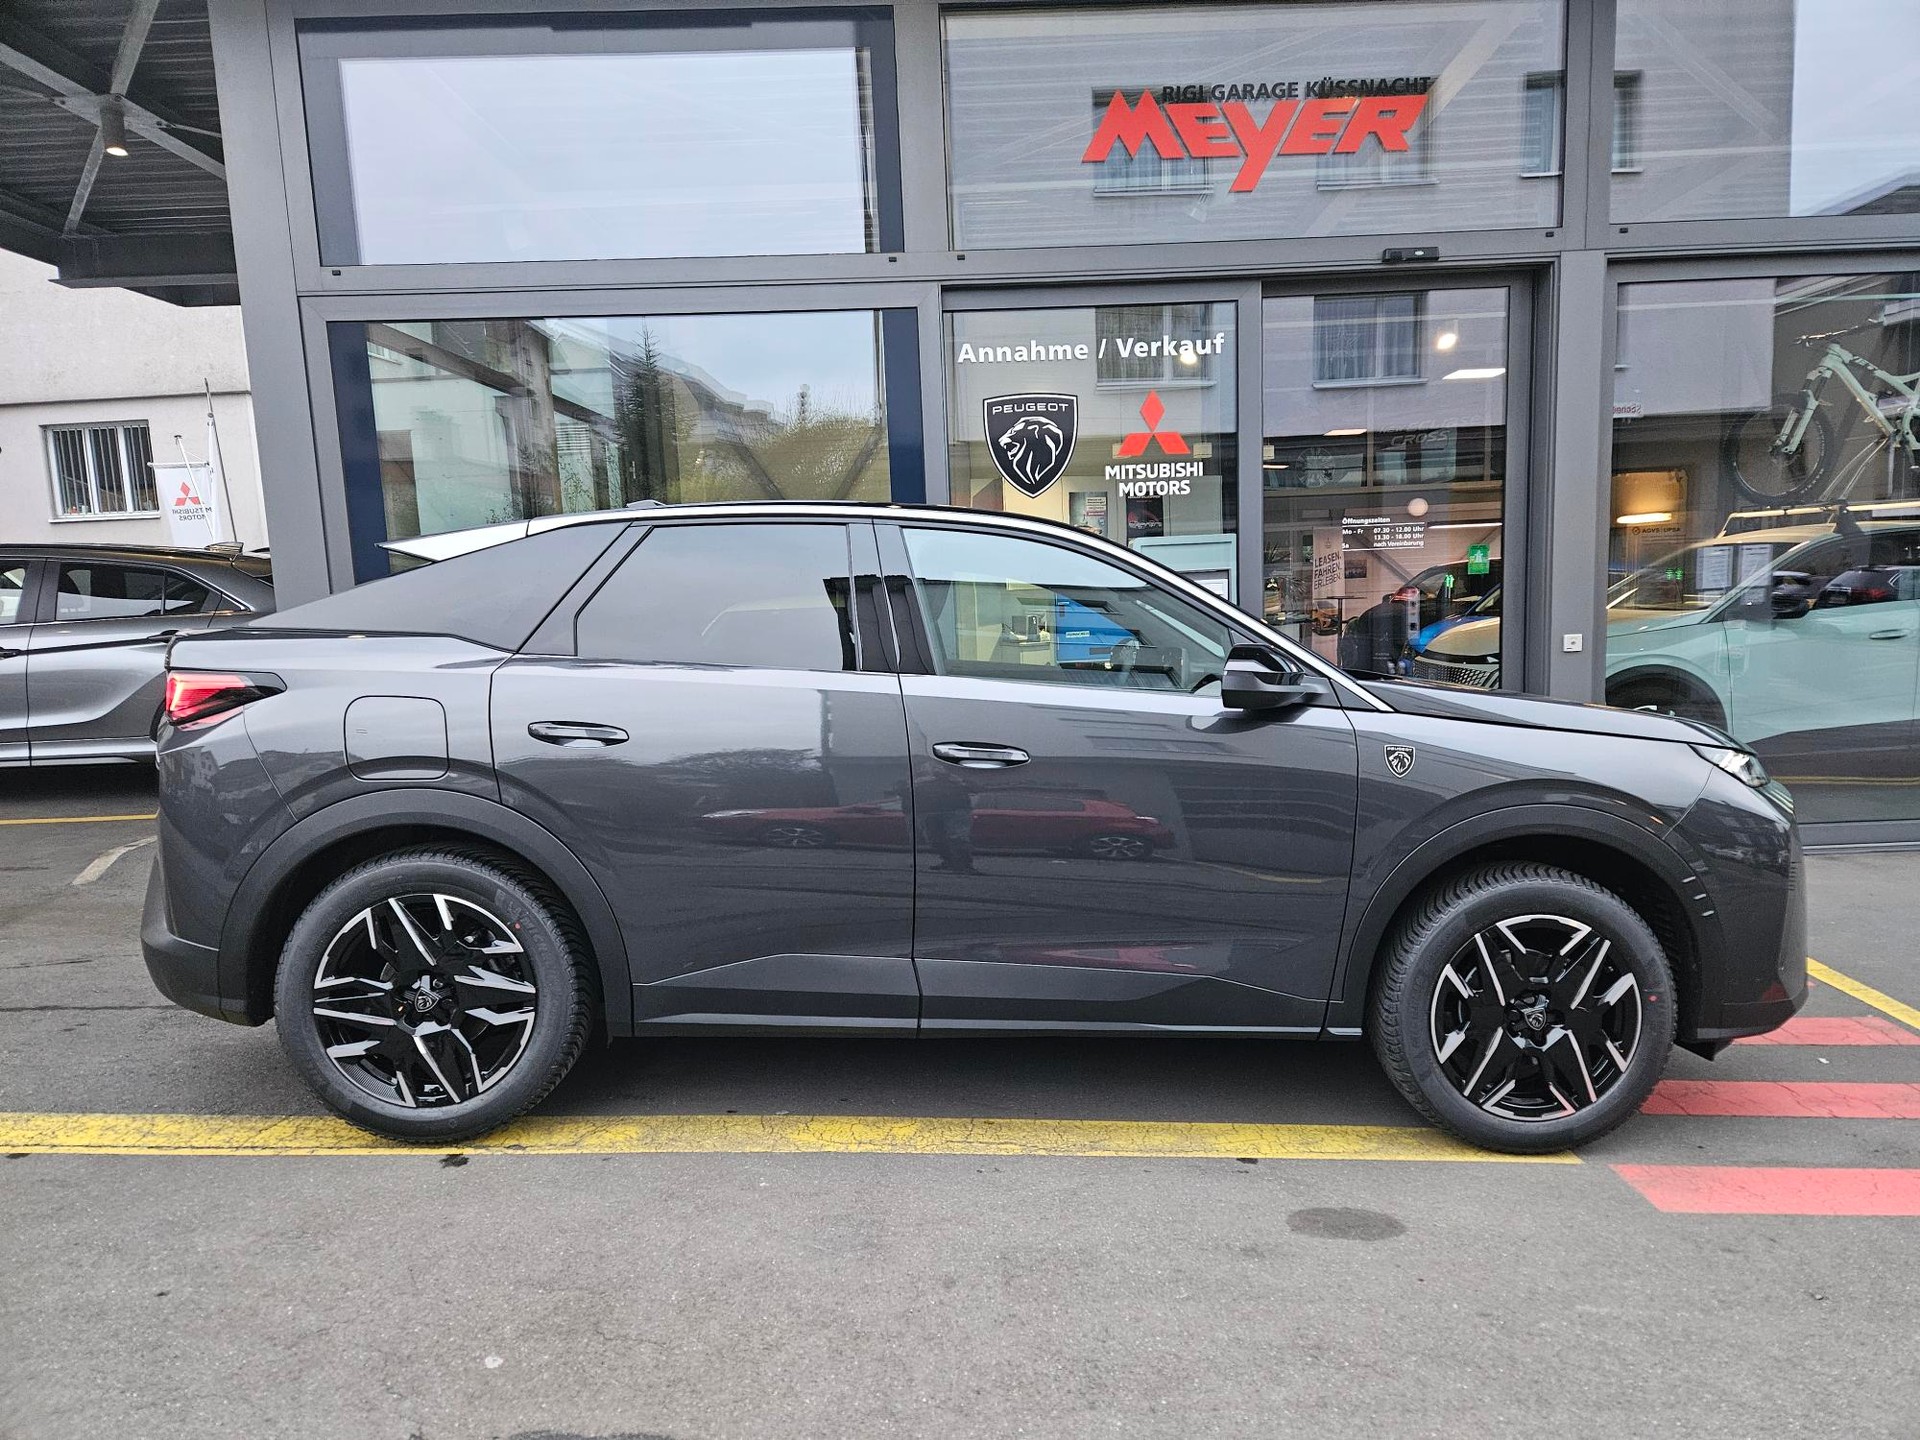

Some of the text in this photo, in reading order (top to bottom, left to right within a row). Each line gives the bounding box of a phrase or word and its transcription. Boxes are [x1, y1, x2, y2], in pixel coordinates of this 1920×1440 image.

[1162, 75, 1431, 102] RIGI GARAGE KÜSSNACHT
[1081, 88, 1429, 193] MEYER
[957, 332, 1225, 363] Annahme / Verkauf
[992, 402, 1069, 415] PEUGEOT
[1105, 461, 1204, 481] MITSUBISHI
[1118, 480, 1191, 498] MOTORS
